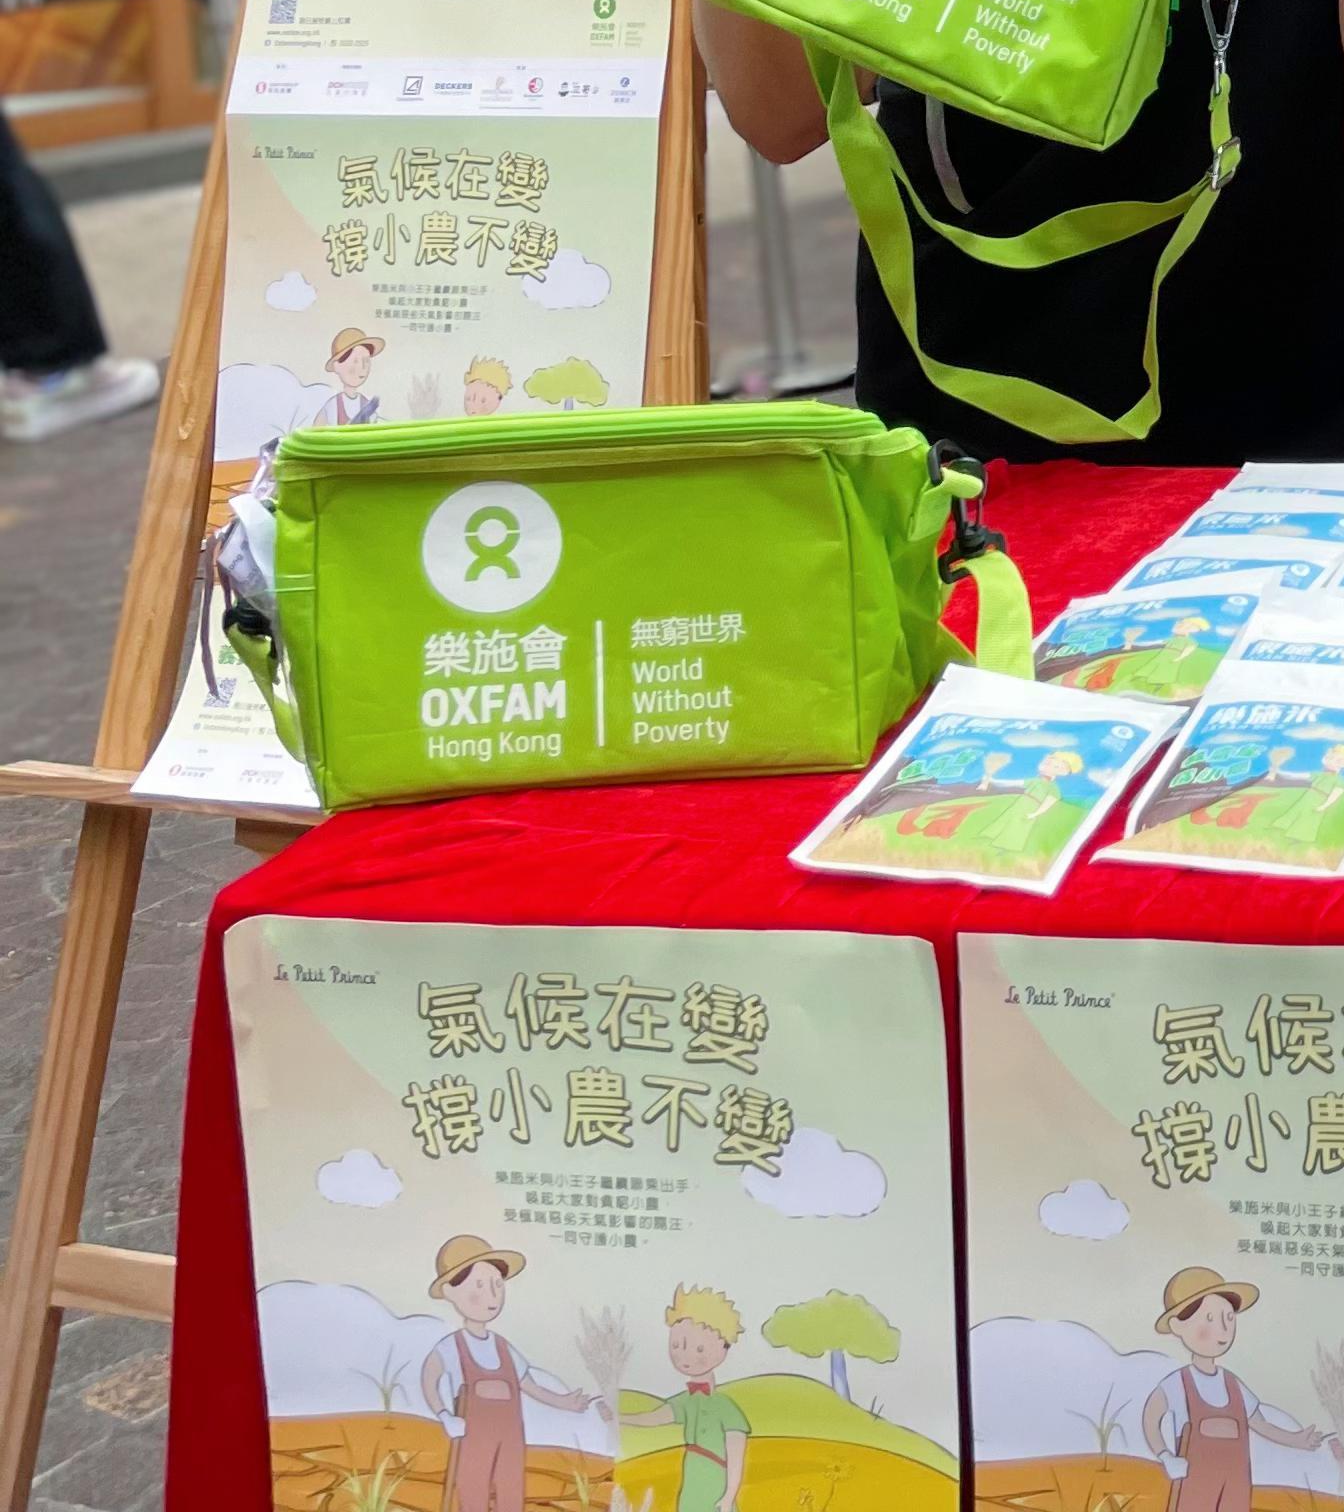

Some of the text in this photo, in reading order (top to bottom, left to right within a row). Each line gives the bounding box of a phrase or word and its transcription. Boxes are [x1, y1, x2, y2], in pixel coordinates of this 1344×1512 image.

[974, 5, 1051, 51] Without
[961, 30, 1036, 75] Poverty
[337, 146, 549, 213] 氣候在變
[323, 210, 558, 283] 撐小農不變
[423, 624, 568, 678] 樂施會
[631, 613, 746, 648] 無窮世界
[632, 659, 704, 684] World
[420, 683, 567, 728] OXFAM
[632, 687, 733, 713] Without
[428, 729, 562, 761] Hong Kong
[632, 716, 730, 746] Poverty
[274, 964, 379, 985] Le Petit Prince
[1005, 983, 1113, 1009] Le Petit Prince
[418, 972, 769, 1074] 氣候在變
[402, 1065, 793, 1177] 撐小農不變
